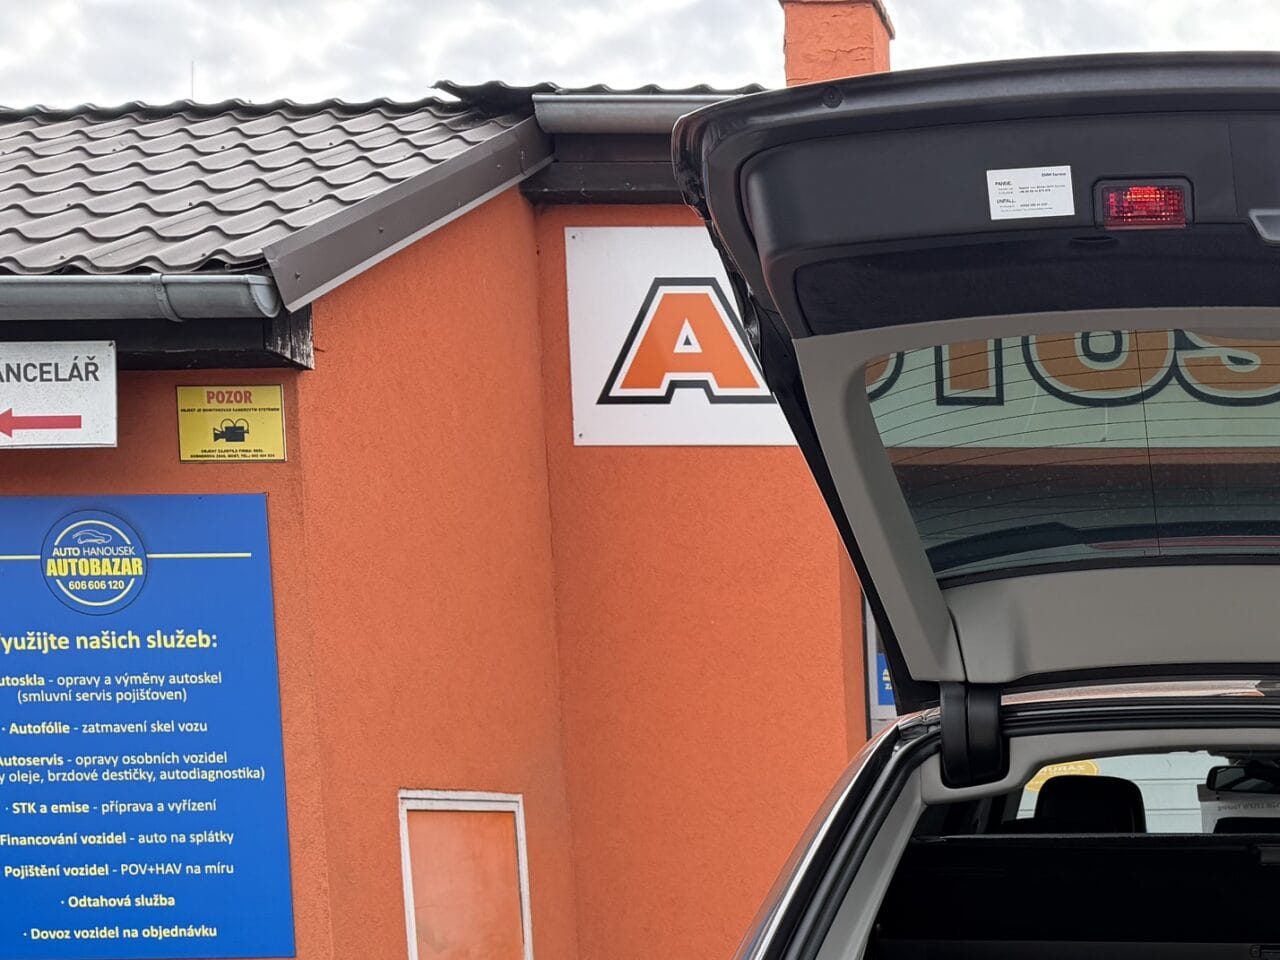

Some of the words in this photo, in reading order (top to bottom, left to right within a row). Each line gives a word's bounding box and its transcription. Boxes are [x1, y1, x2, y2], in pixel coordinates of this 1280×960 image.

[0, 355, 100, 383] NCELÁŘ
[206, 390, 253, 404] POZOR
[52, 547, 80, 556] AUTO
[82, 545, 135, 556] HANOUSEK
[46, 557, 143, 577] AUTOBAZAR
[68, 580, 87, 590] 606
[88, 580, 106, 590] 606
[107, 580, 125, 590] 120
[0, 631, 70, 654] yužijte
[76, 630, 141, 649] našich
[146, 629, 217, 648] služeb:
[57, 676, 100, 688] opravy
[104, 676, 112, 685] a
[115, 672, 165, 687] výměny
[169, 671, 222, 684] autoskel
[17, 689, 72, 704] (smluvní
[75, 689, 112, 701] servis
[116, 687, 187, 703] pojišťoven)
[9, 721, 70, 734] Autofólie
[82, 720, 147, 733] zatmavení
[150, 719, 175, 733] skel
[178, 721, 208, 732] vozu
[75, 755, 118, 767] opravy
[122, 752, 180, 764] osobních
[183, 751, 228, 764] vozidel
[9, 770, 44, 784] oleje,
[48, 769, 98, 781] brzdové
[101, 767, 156, 783] destičky,
[159, 766, 265, 782] autodiagnostika)
[12, 802, 37, 814] STK
[40, 804, 48, 813] a
[51, 801, 90, 813] emise
[101, 799, 153, 815] příprava
[157, 803, 164, 812] a
[168, 798, 217, 814] vyřízení
[0, 832, 77, 846] Financování
[80, 832, 127, 845] vozidel
[138, 833, 167, 844] auto
[170, 833, 186, 843] na
[190, 830, 234, 846] splátky
[4, 864, 60, 880] Pojištění
[63, 864, 109, 876] vozidel
[120, 863, 182, 875] POV+HAV
[186, 865, 201, 874] na
[205, 861, 234, 874] míru
[68, 894, 131, 908] Odtahová
[135, 895, 176, 907] služba
[31, 928, 71, 940] Dovoz
[73, 926, 120, 939] vozidel
[123, 928, 139, 938] na
[142, 925, 217, 941] objednávku
